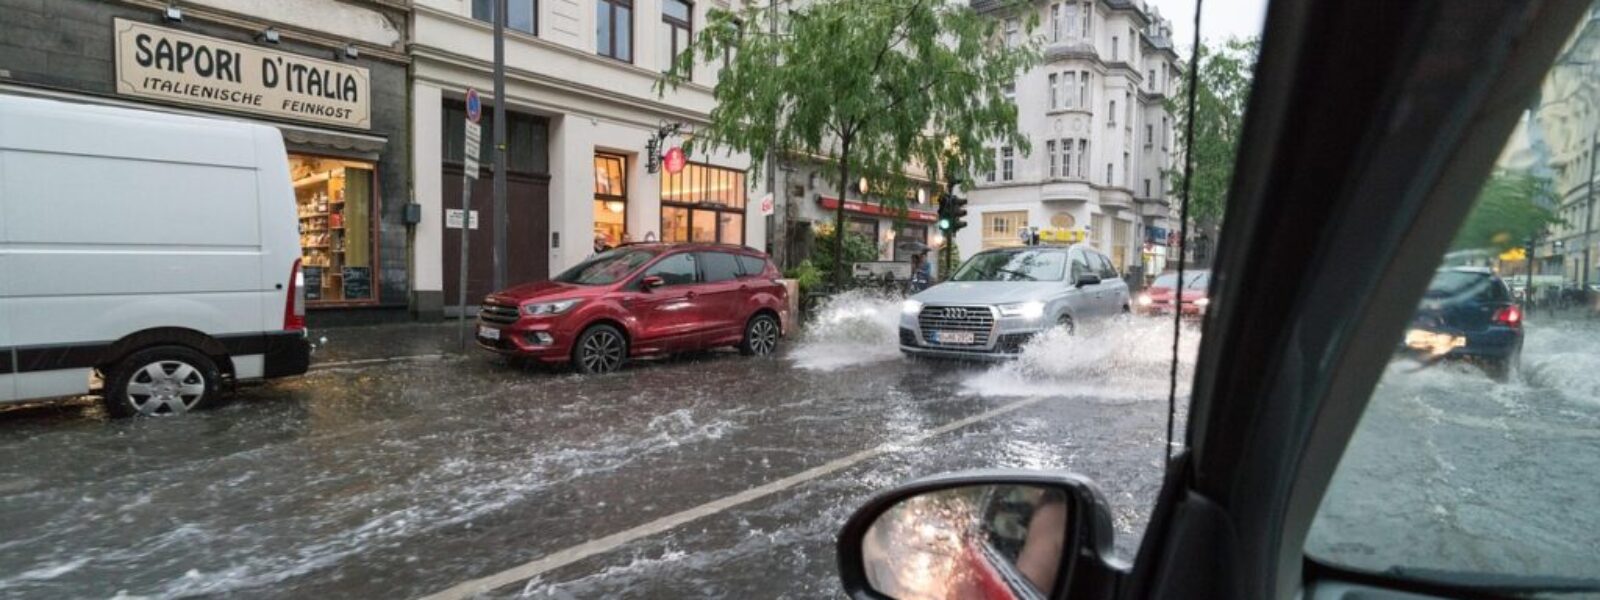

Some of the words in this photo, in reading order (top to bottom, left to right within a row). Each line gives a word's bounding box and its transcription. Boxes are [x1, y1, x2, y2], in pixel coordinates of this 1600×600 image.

[135, 33, 242, 84] SAPORI
[261, 56, 358, 103] D'ITALIA
[142, 77, 264, 106] ITALIENISCHE
[281, 99, 353, 120] FEINKOST
